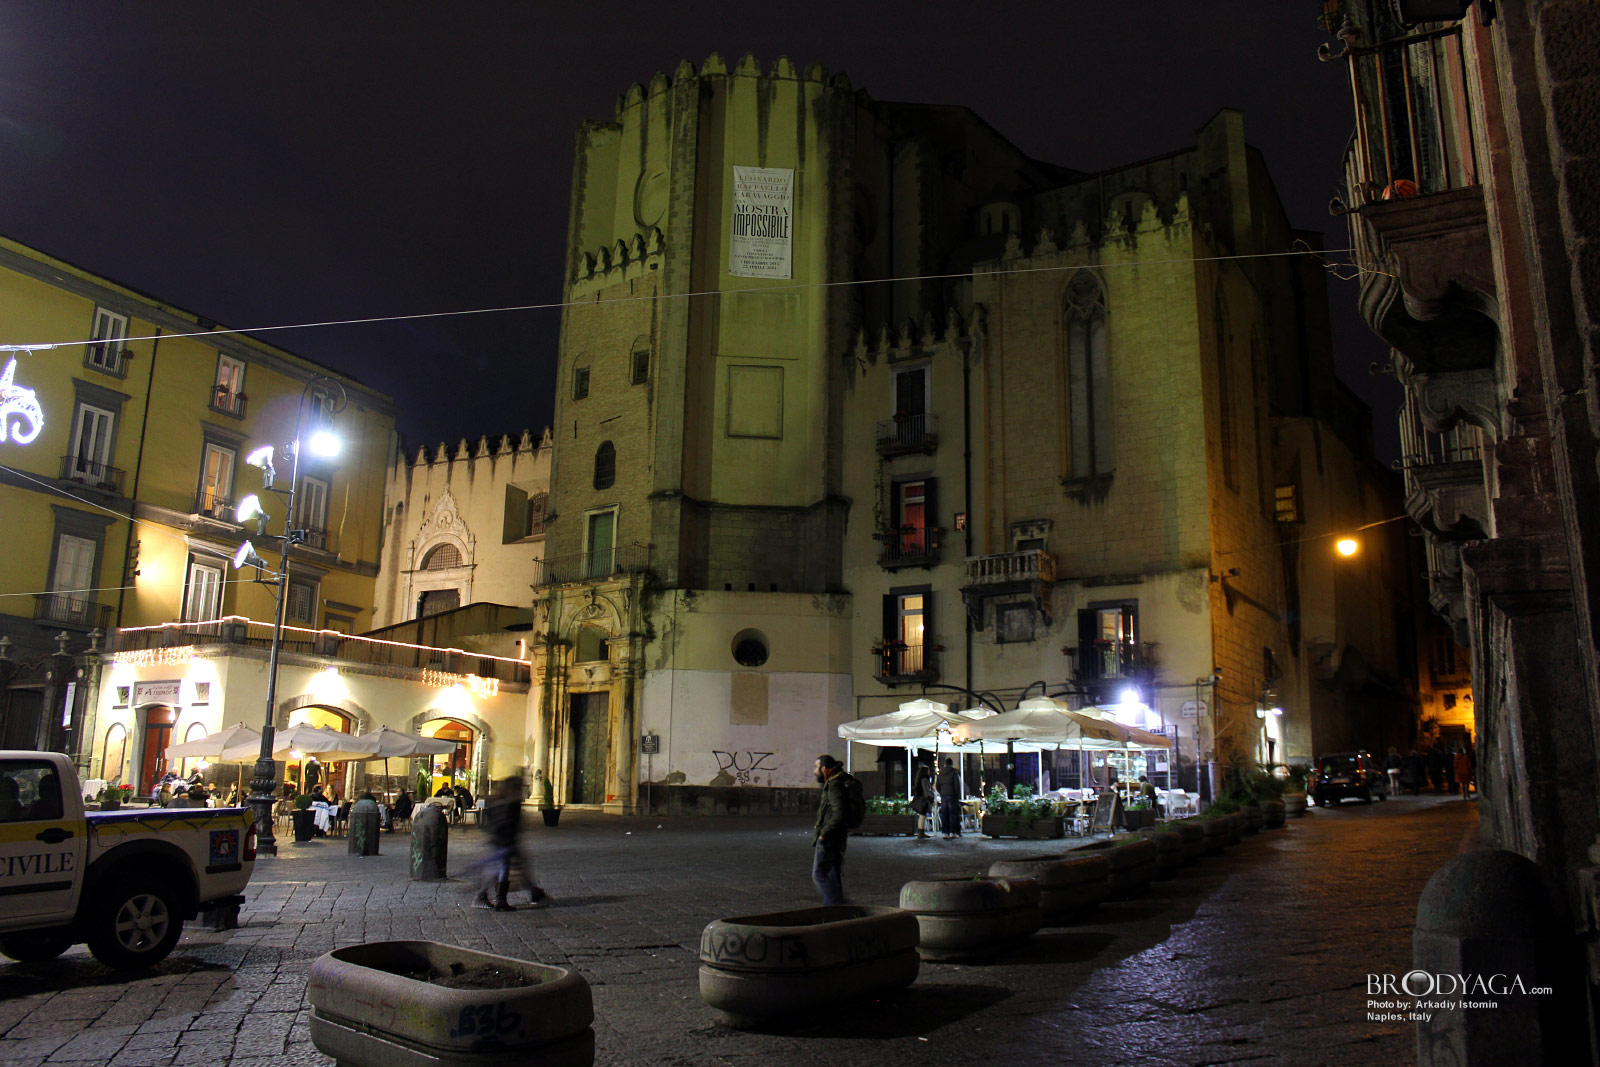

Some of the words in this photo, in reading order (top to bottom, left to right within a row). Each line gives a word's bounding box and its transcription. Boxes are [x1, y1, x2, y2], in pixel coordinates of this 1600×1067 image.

[739, 175, 786, 183] LEONARDO
[737, 183, 788, 192] RAFFAELLO
[734, 192, 790, 200] CARAVAGGIO
[736, 204, 788, 215] MOSTRA
[733, 213, 789, 239] IMPOSSIBILE
[712, 750, 778, 772] DUZ
